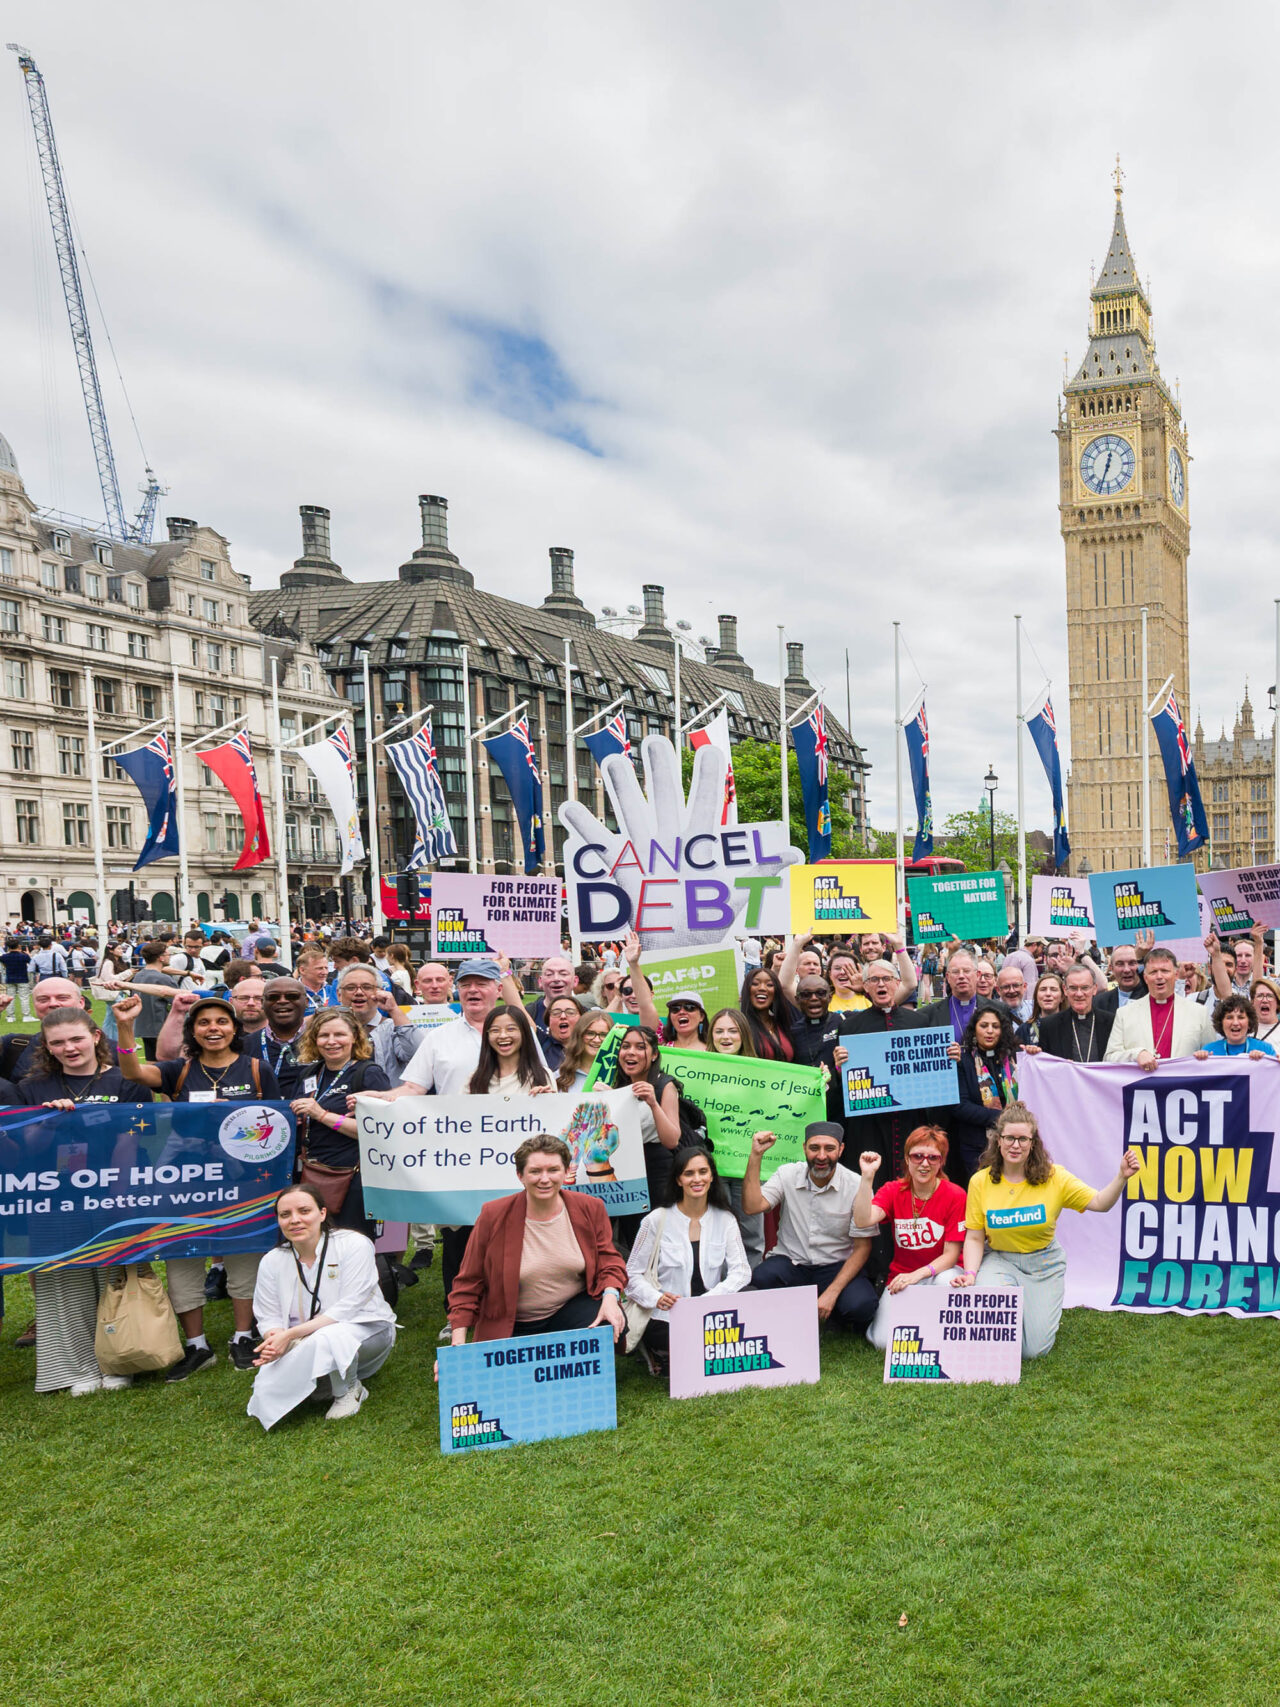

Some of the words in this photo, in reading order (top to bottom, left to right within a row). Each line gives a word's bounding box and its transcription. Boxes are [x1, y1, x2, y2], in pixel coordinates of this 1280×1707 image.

[572, 830, 781, 878] CANCEL
[815, 878, 835, 888] ACT
[1238, 872, 1256, 882] FOR
[492, 882, 514, 894] FOR
[517, 883, 557, 895] PEOPLE
[932, 880, 977, 893] TOGETHER
[978, 878, 996, 888] FOR
[1115, 884, 1135, 896] ACT
[1237, 883, 1255, 894] FOR
[815, 888, 840, 898] NOW
[964, 891, 997, 904] NATURE
[1052, 888, 1069, 898] ACT
[1245, 893, 1262, 903] FOR
[1263, 890, 1280, 901] NAT
[483, 896, 505, 907] FOR
[508, 896, 556, 908] CLIMATE
[576, 876, 782, 933] DEBT
[815, 898, 856, 909] CHANGE
[1051, 898, 1072, 907] NOW
[1116, 895, 1141, 907] NOW
[1212, 899, 1227, 908] ACT
[438, 910, 460, 921] ACT
[488, 909, 510, 921] FOR
[513, 910, 556, 922] NATURE
[815, 908, 862, 919] FOREVER
[1051, 906, 1085, 917] CHANGE
[1117, 904, 1159, 918] CHANGE
[1214, 906, 1233, 916] NOW
[1217, 912, 1248, 923] CHANGE
[438, 921, 464, 931] NOW
[919, 924, 944, 932] CHANGE
[1050, 916, 1089, 927] FOREVER
[1118, 915, 1165, 930] FOREVER
[438, 931, 481, 942] CHANGE
[438, 942, 486, 952] FOREVER
[891, 1037, 912, 1048] FOR
[914, 1033, 950, 1046] PEOPLE
[885, 1051, 906, 1062] FOR
[891, 1063, 911, 1075] FOR
[913, 1059, 953, 1074] NATURE
[675, 1066, 765, 1084] Companions
[771, 1080, 786, 1091] of
[787, 1081, 822, 1096] Jesus
[848, 1070, 867, 1081] ACT
[848, 1078, 871, 1090] NOW
[849, 1088, 887, 1100] CHANGE
[704, 1098, 742, 1114] Hope.
[850, 1096, 892, 1110] FOREVER
[1129, 1089, 1232, 1145] ACT
[362, 1116, 394, 1137] Cry
[402, 1116, 427, 1135] of
[434, 1115, 472, 1134] the
[480, 1114, 547, 1135] Earth,
[367, 1149, 396, 1171] Cry
[402, 1149, 428, 1168] of
[434, 1148, 471, 1166] the
[0, 1170, 60, 1192] MS
[70, 1168, 120, 1188] OF
[130, 1162, 224, 1186] HOPE
[1127, 1145, 1254, 1203] NOW
[60, 1200, 77, 1212] a
[83, 1194, 161, 1210] better
[169, 1186, 239, 1204] world
[991, 1209, 1042, 1225] tearfund
[899, 1222, 937, 1247] aid
[948, 1294, 971, 1308] FOR
[974, 1294, 1018, 1308] PEOPLE
[705, 1313, 734, 1330] ACT
[940, 1310, 963, 1324] FOR
[965, 1311, 1017, 1324] CLIMATE
[704, 1328, 739, 1345] NOW
[894, 1328, 916, 1341] ACT
[943, 1327, 966, 1341] FOR
[970, 1327, 1016, 1341] NATURE
[484, 1342, 566, 1368] TOGETHER
[570, 1338, 600, 1355] FOR
[704, 1340, 763, 1360] CHANGE
[892, 1340, 920, 1353] NOW
[705, 1354, 771, 1375] FOREVER
[891, 1353, 936, 1365] CHANGE
[534, 1359, 601, 1384] CLIMATE
[890, 1365, 939, 1378] FOREVER
[452, 1404, 475, 1417] ACT
[452, 1413, 479, 1428] NOW
[452, 1421, 496, 1438] CHANGE
[453, 1430, 501, 1448] FOREVER
